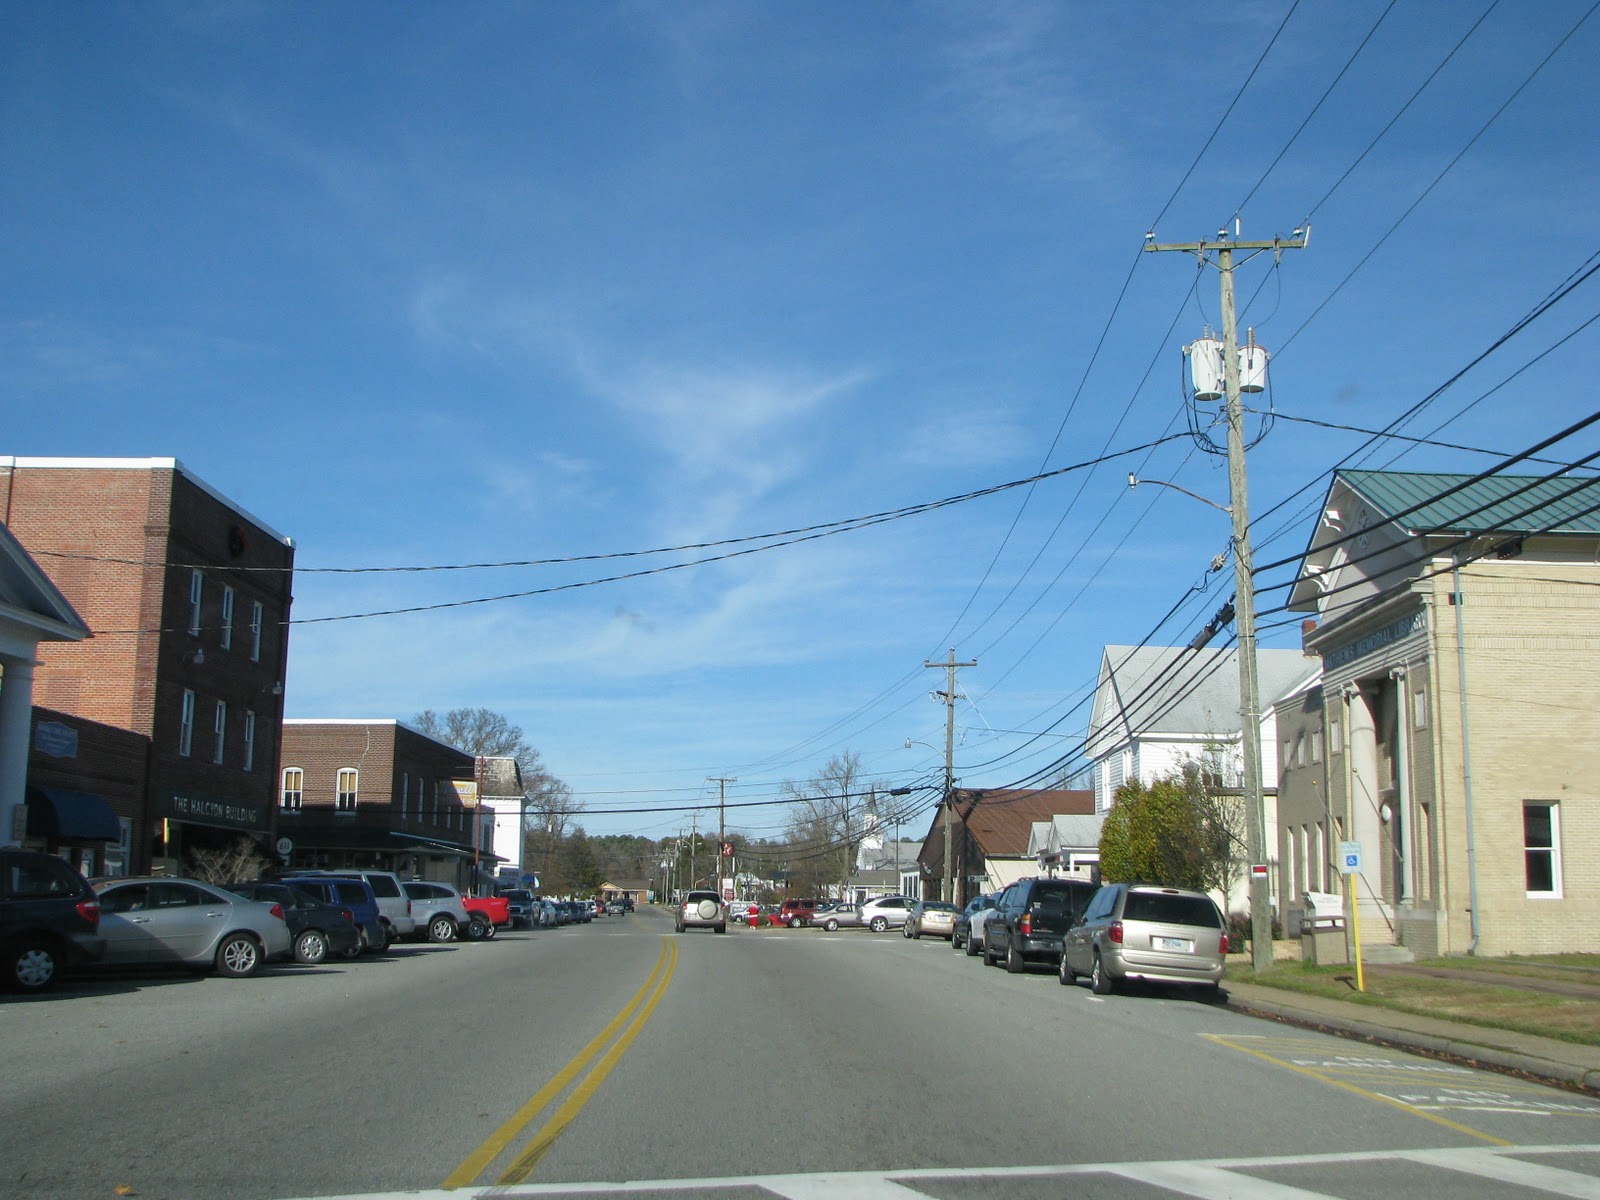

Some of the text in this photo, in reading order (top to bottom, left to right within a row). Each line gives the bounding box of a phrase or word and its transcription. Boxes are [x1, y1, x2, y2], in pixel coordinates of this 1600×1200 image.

[173, 796, 257, 823] THE HALCYON BUILDING
